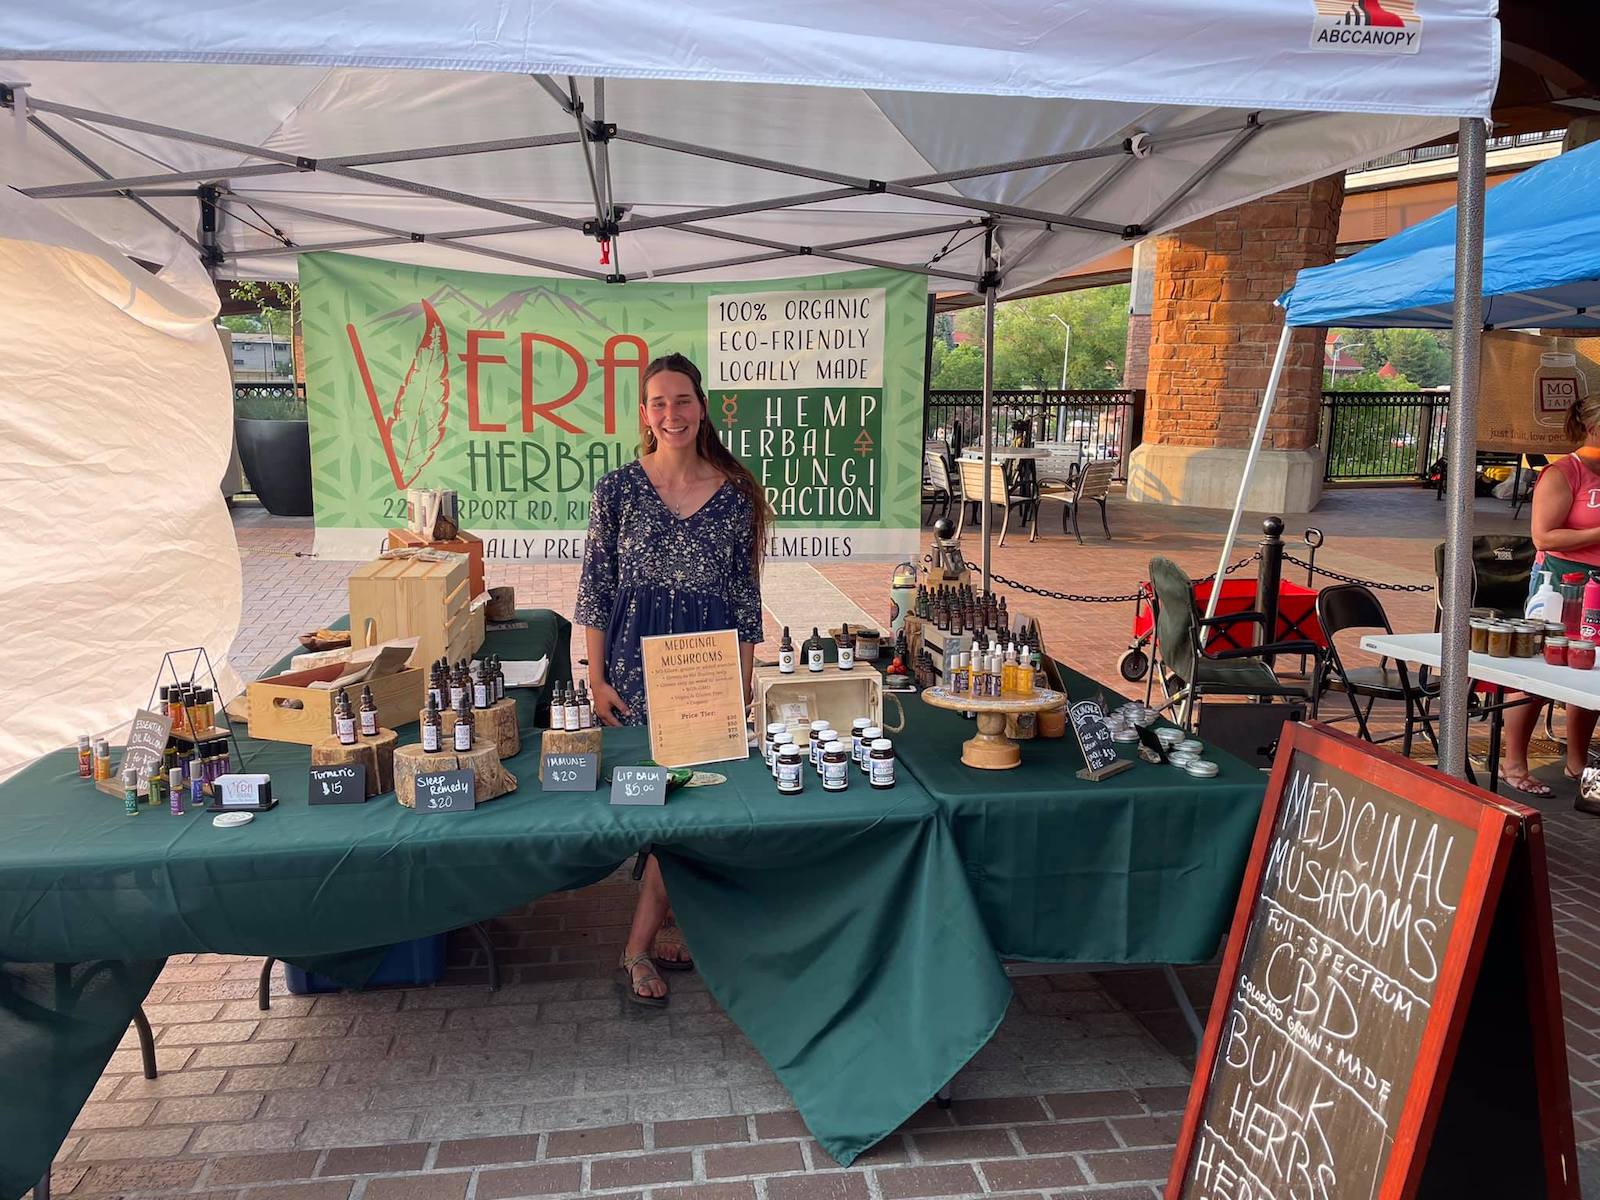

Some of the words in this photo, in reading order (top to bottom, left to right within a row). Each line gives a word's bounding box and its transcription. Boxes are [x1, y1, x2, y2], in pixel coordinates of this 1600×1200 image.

[1317, 29, 1416, 46] ABCCANOPY
[719, 301, 768, 322] 100%
[784, 297, 870, 321] ORGANIC
[719, 328, 869, 352] ECO-FRIENDLY
[719, 360, 800, 382] LOCALLY
[816, 358, 869, 381] MADE
[346, 298, 649, 491] VERA
[765, 395, 877, 427] HEMP
[761, 458, 875, 487] FUNGI
[527, 500, 558, 523] RD,
[764, 486, 874, 516] RACTION
[764, 536, 852, 558] EMEDIES
[664, 636, 717, 651] MEDICINAL
[660, 650, 723, 668] MUSHROOMS
[310, 767, 356, 780] Turmeric
[546, 757, 587, 768] IMMUNE
[416, 775, 446, 788] Sleep
[429, 779, 469, 796] Remedy
[552, 770, 577, 782] $20
[616, 771, 632, 782] LIP
[636, 771, 660, 781] BALM
[321, 780, 344, 796] $15
[427, 796, 453, 809] $20
[1281, 769, 1457, 911] MEDICINAL
[1264, 836, 1438, 984] MUSHROOMS
[1265, 942, 1359, 1040] CBD
[1240, 974, 1284, 1021] COLORADO
[1286, 1015, 1323, 1051] GROWN
[1336, 1048, 1392, 1102] MADE
[1225, 1009, 1335, 1167] BULK
